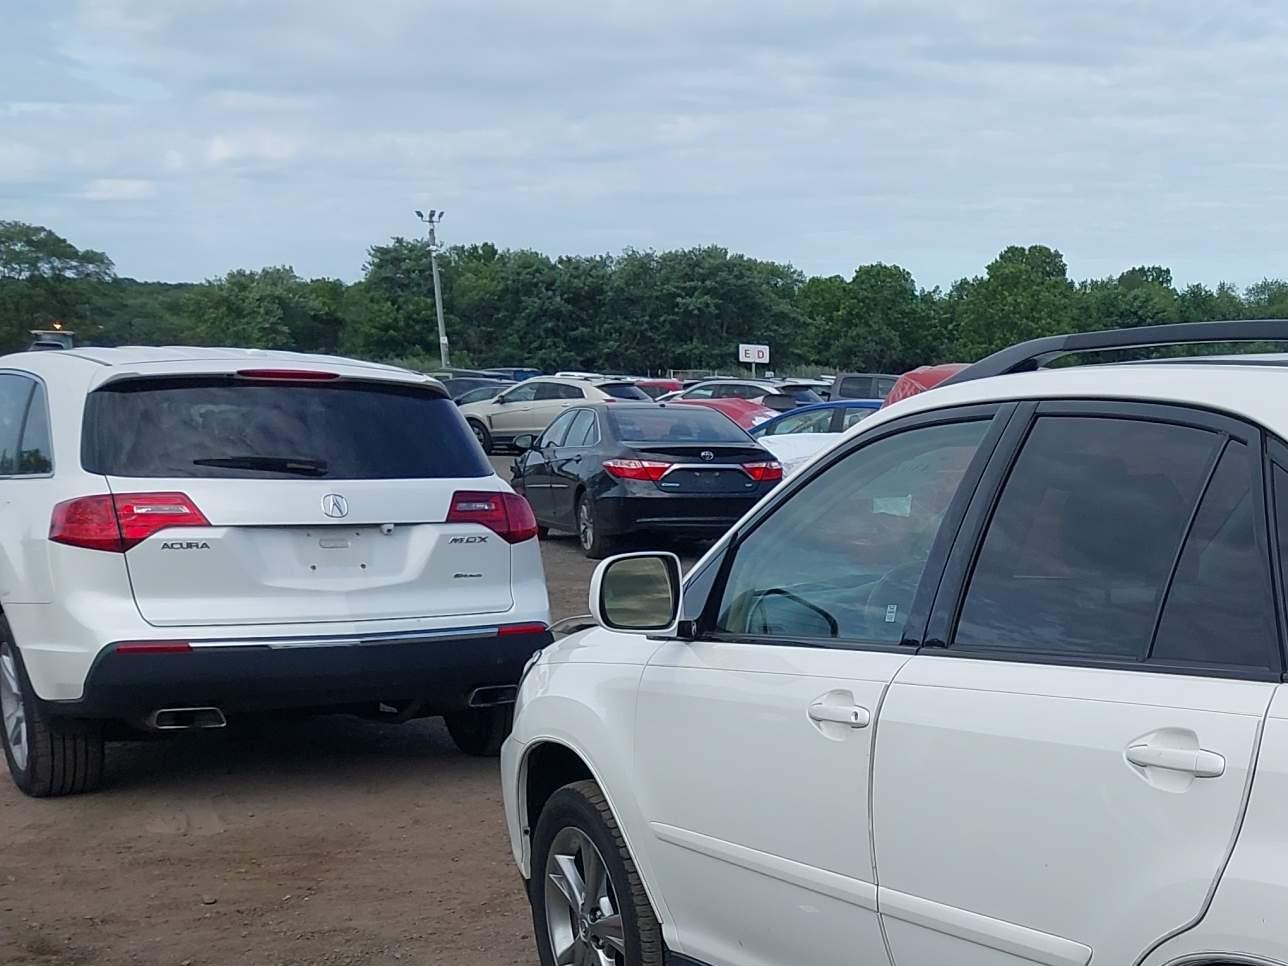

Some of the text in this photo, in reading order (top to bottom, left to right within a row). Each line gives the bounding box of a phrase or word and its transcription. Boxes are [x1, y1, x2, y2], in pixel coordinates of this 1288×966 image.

[744, 349, 765, 360] E D
[160, 541, 210, 550] ACURA
